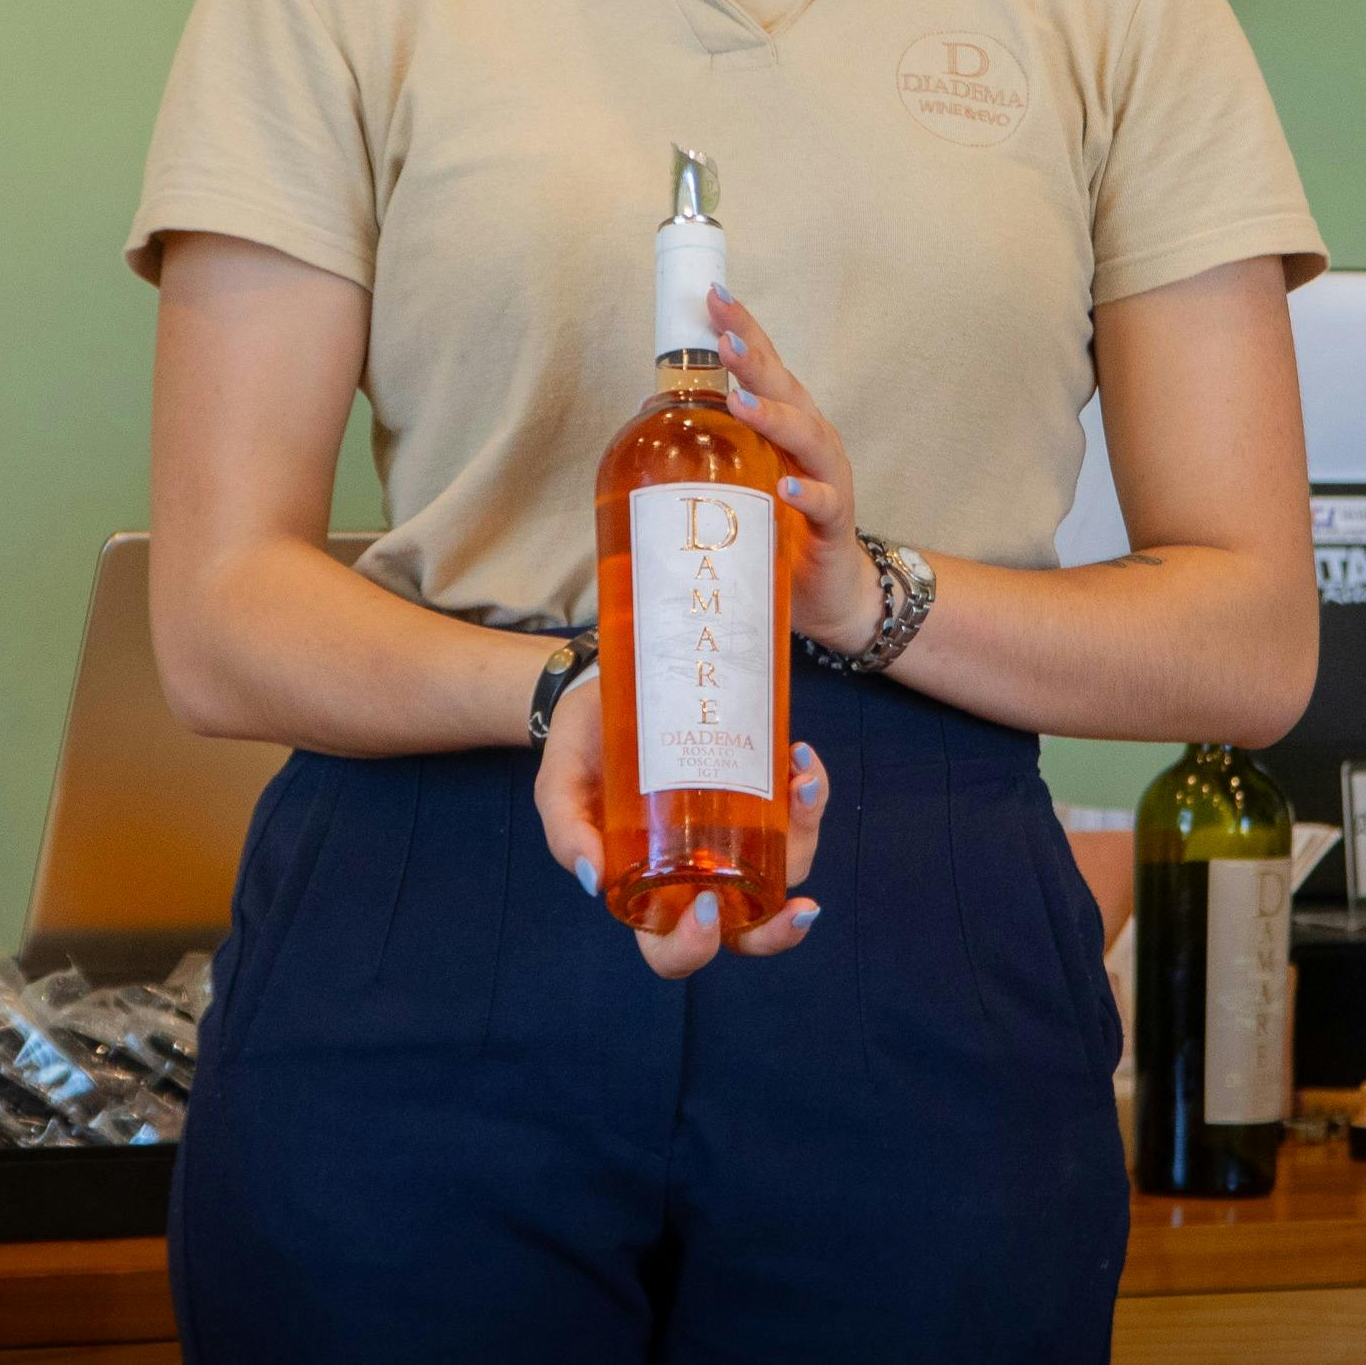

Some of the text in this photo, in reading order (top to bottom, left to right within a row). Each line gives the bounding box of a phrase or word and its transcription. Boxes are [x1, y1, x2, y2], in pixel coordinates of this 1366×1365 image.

[941, 42, 990, 78] D
[900, 73, 1025, 108] DIADEMA
[677, 496, 740, 726] DAMARE
[659, 730, 756, 751] DIADEMA
[681, 746, 736, 758] ROSATO
[676, 756, 739, 770] TOSCANA
[697, 768, 721, 778] IGT
